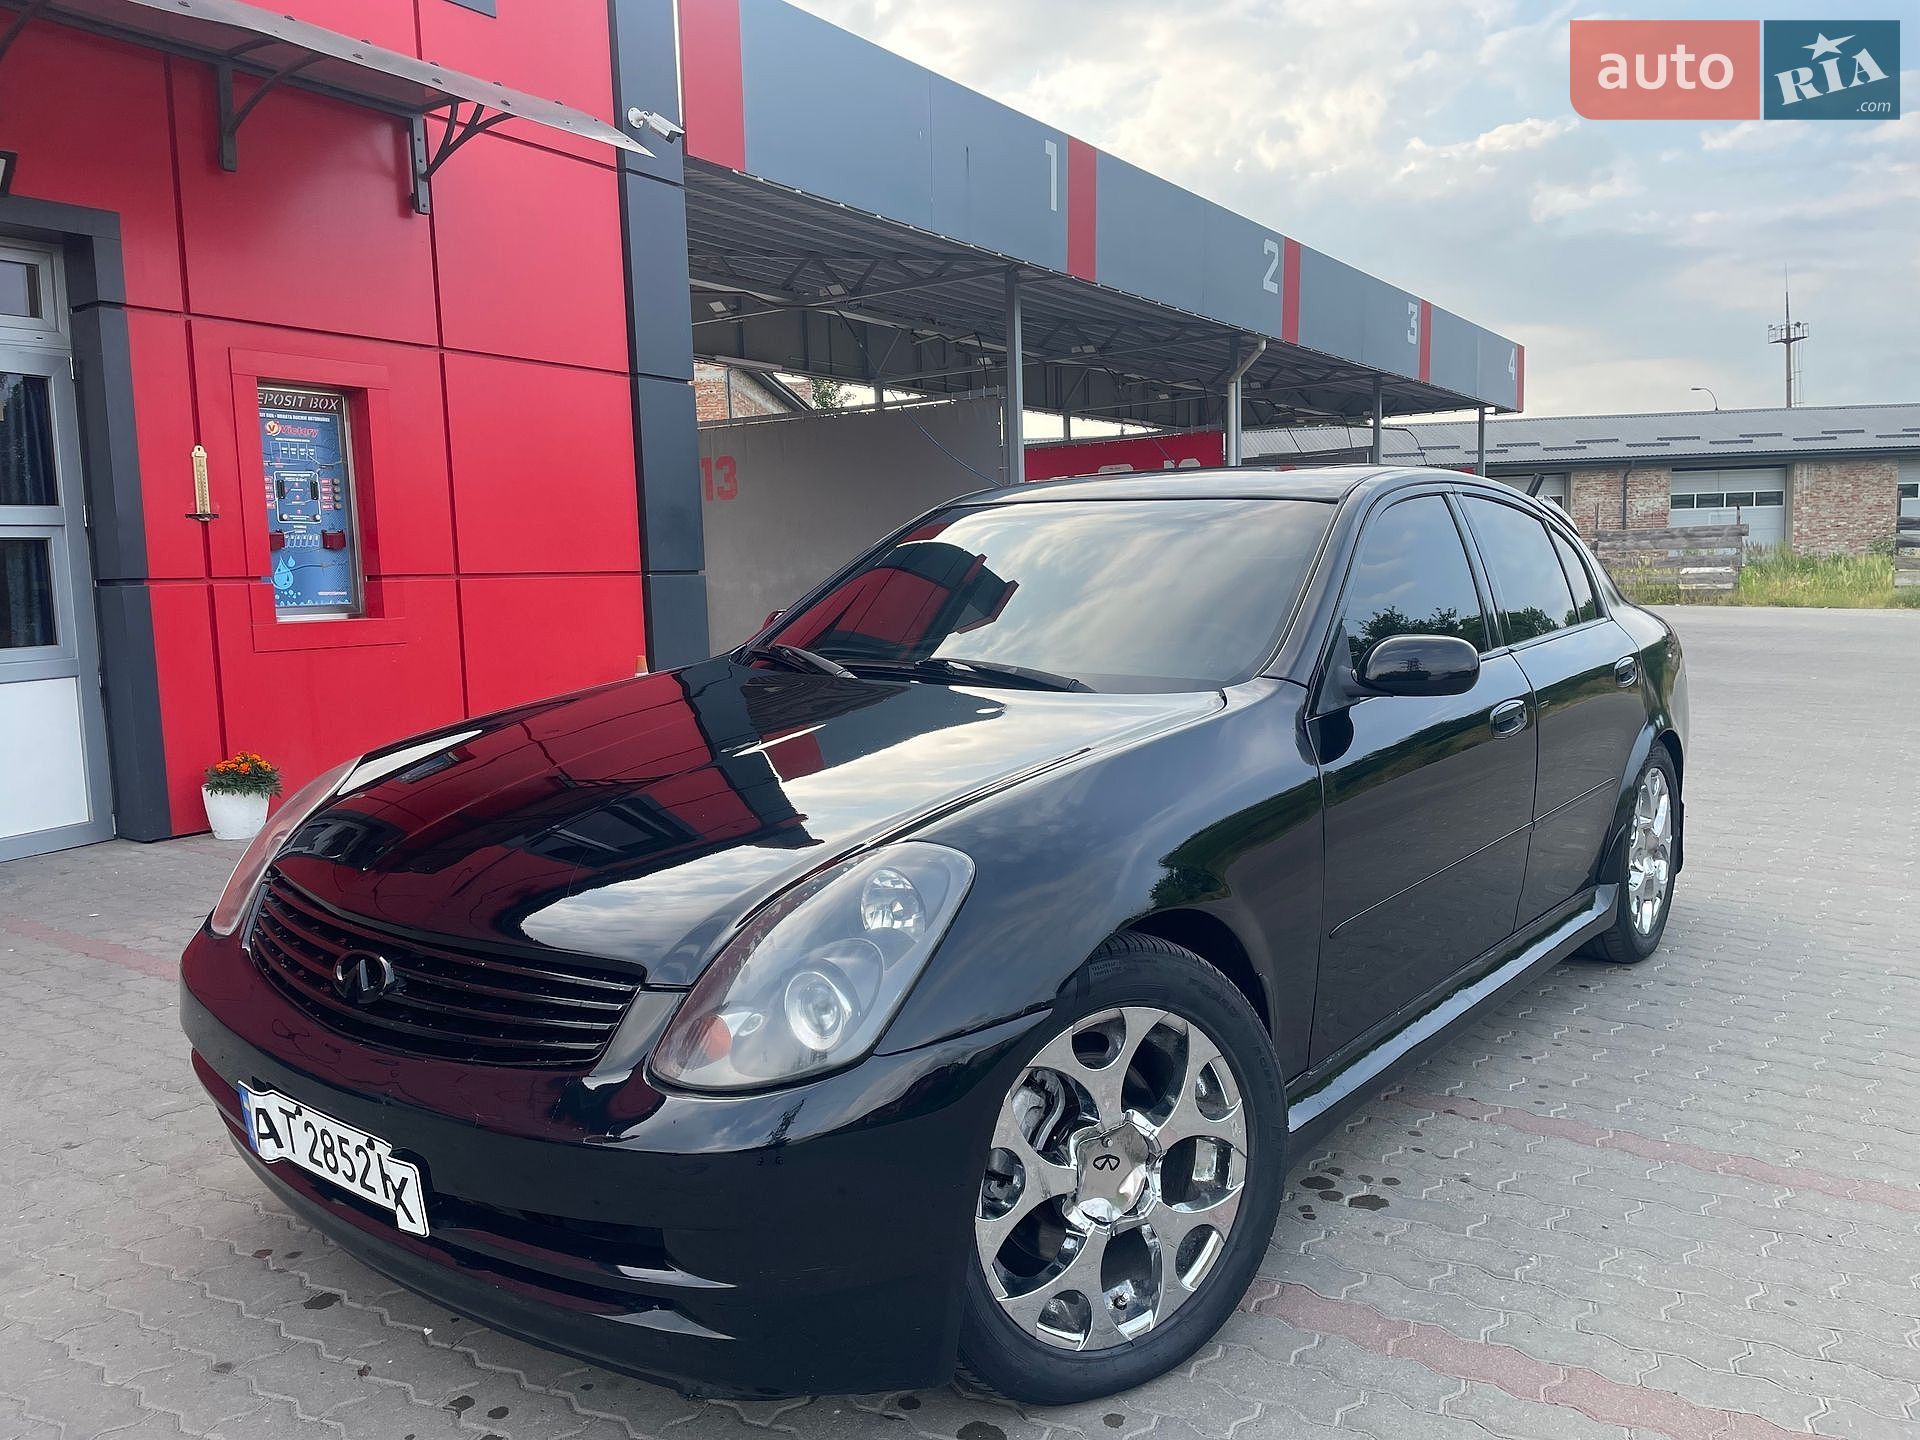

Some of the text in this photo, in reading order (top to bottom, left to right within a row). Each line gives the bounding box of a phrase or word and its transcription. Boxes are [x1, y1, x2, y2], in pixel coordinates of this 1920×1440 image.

[1045, 139, 1058, 212] 1
[1263, 239, 1279, 294] 2
[1407, 302, 1418, 345] 3
[1508, 347, 1516, 381] 4
[309, 397, 339, 410] BOX
[700, 455, 738, 502] 13
